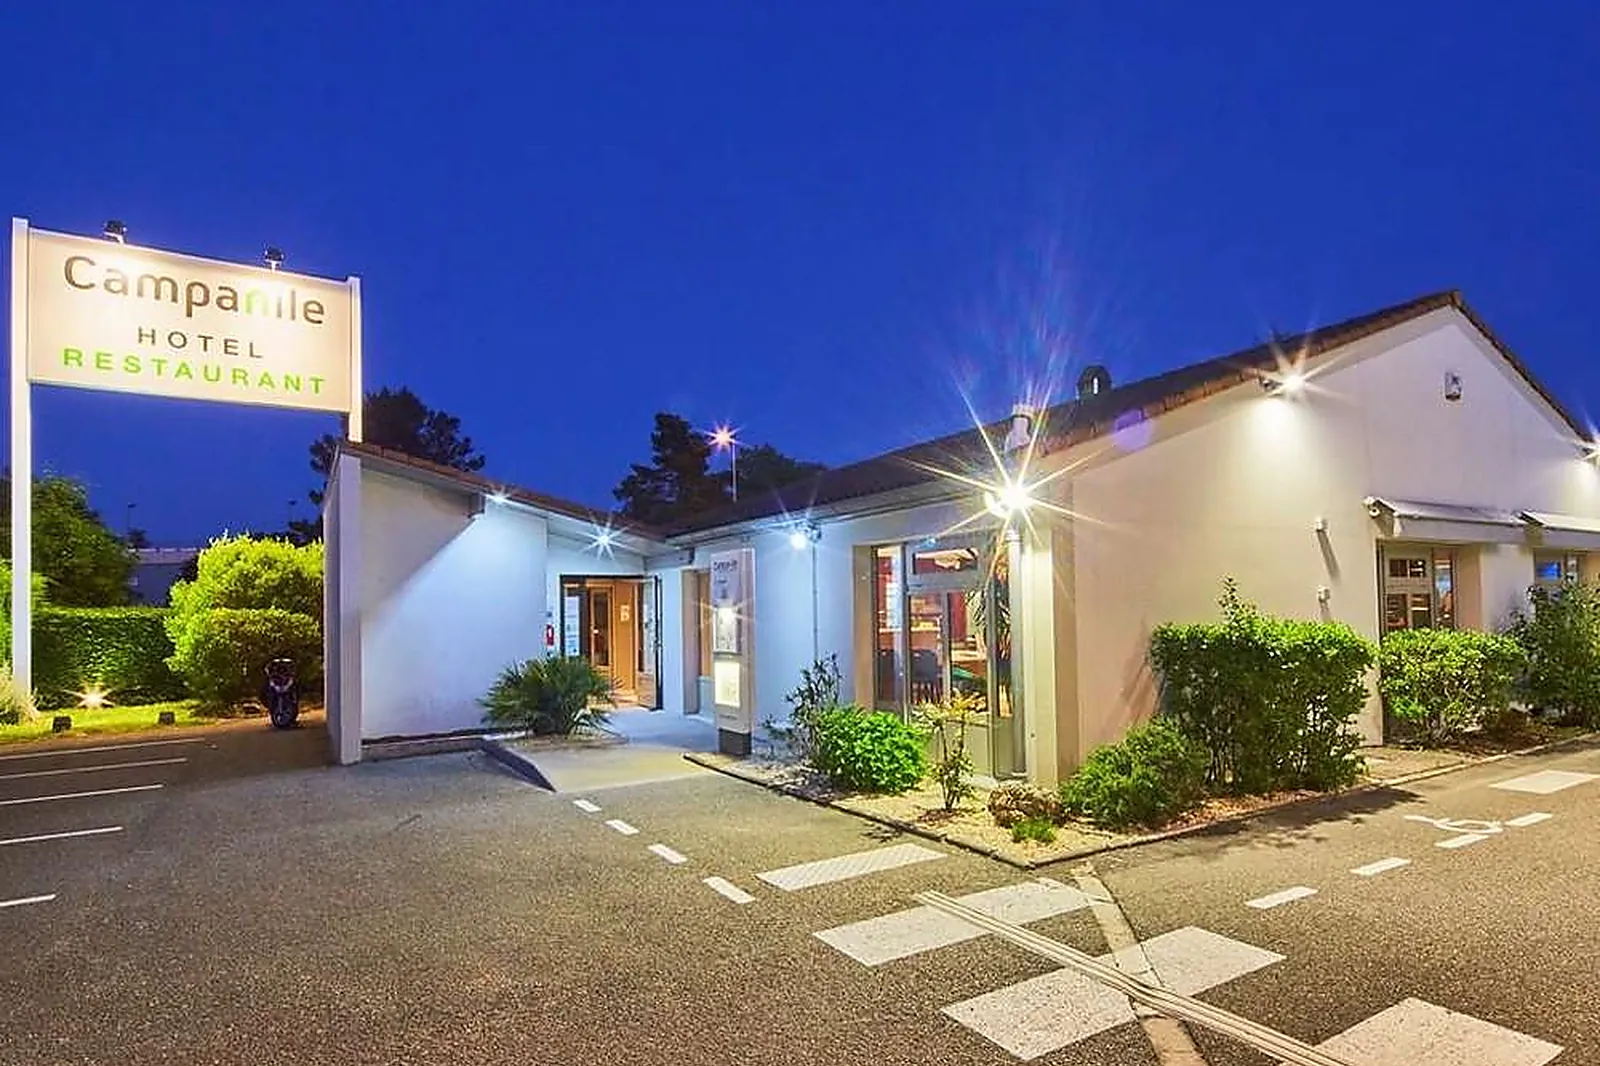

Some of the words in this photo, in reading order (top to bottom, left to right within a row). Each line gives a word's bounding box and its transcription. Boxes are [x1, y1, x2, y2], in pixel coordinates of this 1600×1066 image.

[64, 255, 325, 324] Campanile
[138, 327, 263, 359] HOTEL
[62, 348, 326, 395] RESTAURANT
